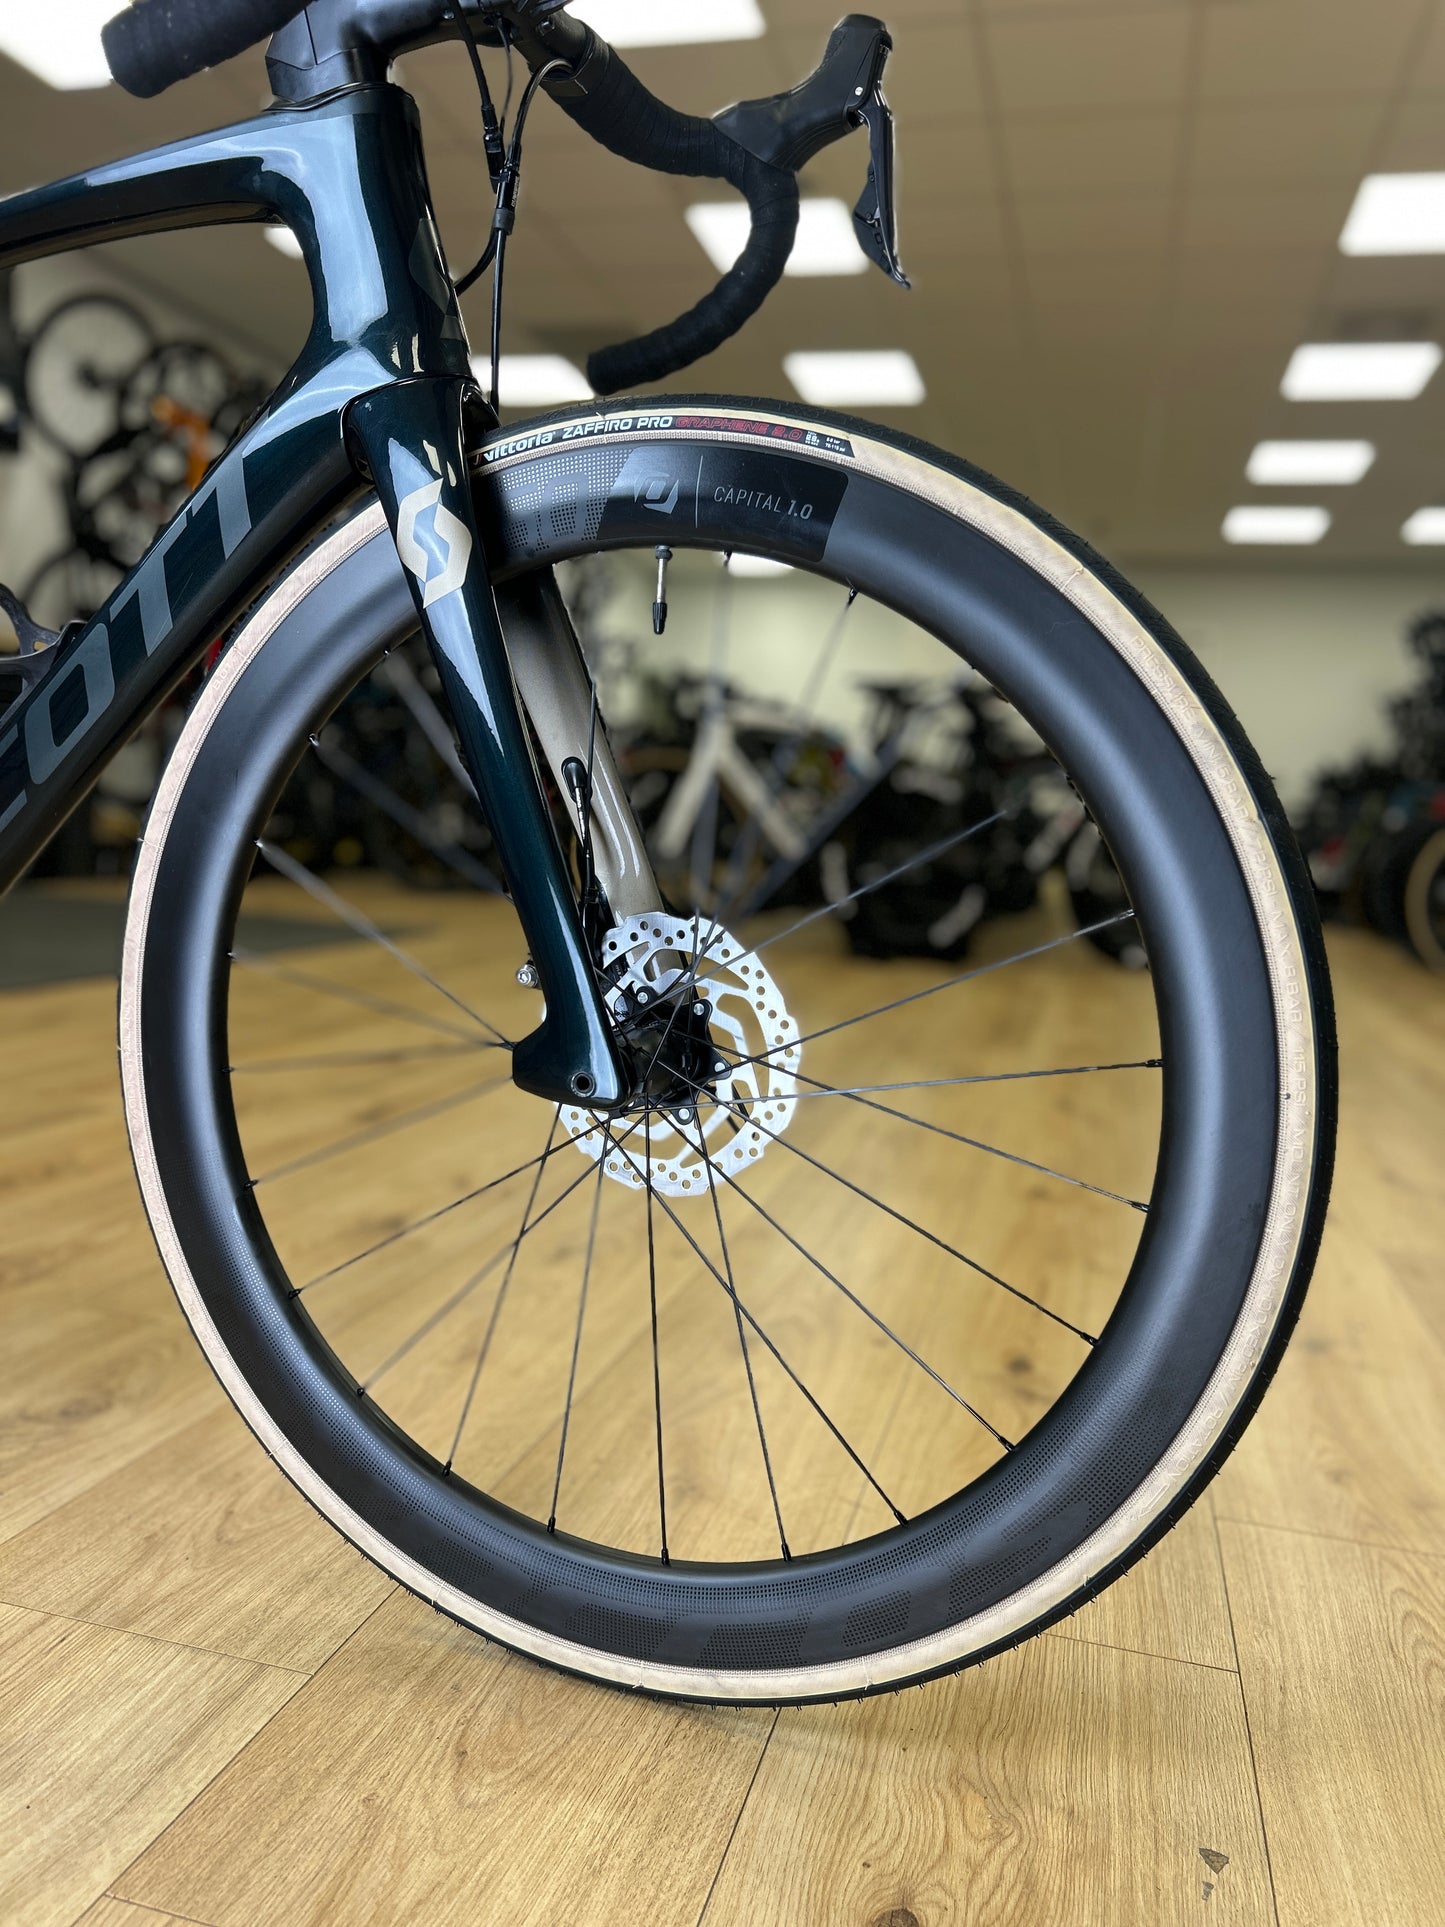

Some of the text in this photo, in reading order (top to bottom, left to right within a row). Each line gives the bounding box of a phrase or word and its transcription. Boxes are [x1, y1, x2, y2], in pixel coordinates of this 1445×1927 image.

[563, 418, 632, 440] ZAFFIRO
[636, 416, 673, 430] PRO
[676, 417, 768, 435] GRAPHENE
[772, 424, 803, 441] 2.0
[713, 486, 814, 521] CAPITAL 1.0
